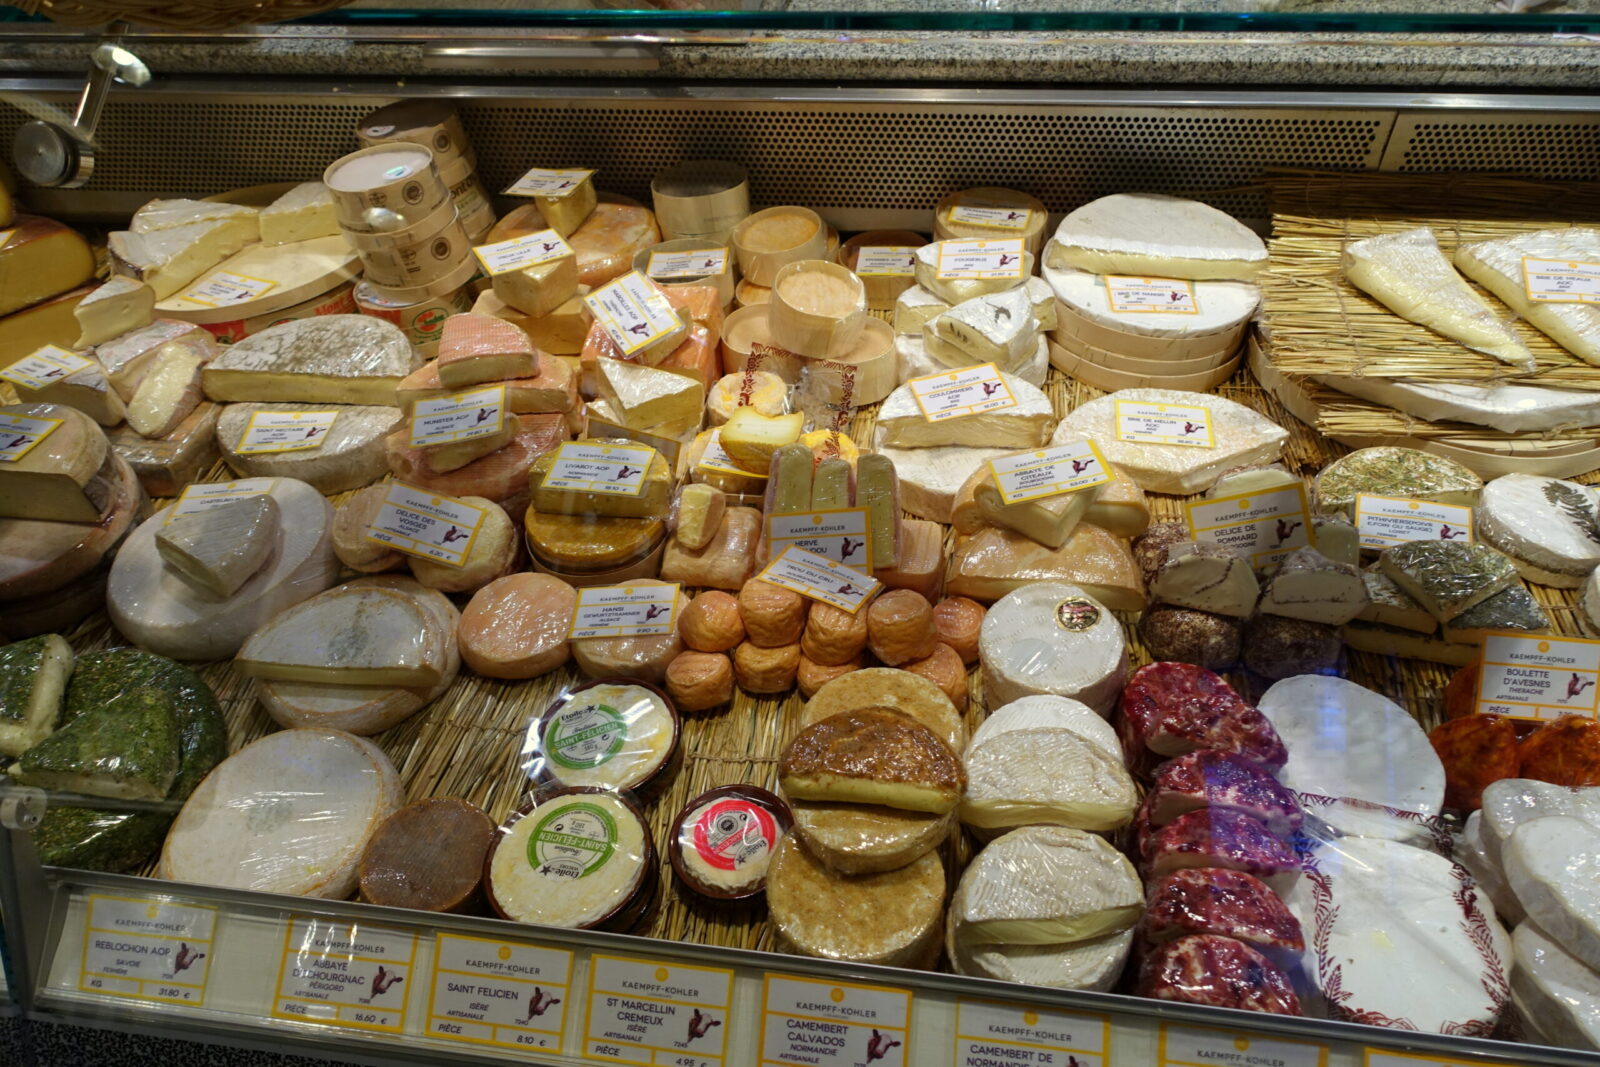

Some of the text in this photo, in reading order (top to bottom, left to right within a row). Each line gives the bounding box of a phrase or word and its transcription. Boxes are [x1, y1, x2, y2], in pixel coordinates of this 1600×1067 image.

[1014, 468, 1043, 477] ABBAYE
[1214, 526, 1242, 537] DELICE
[1509, 653, 1576, 664] KAEMPFF-KOHLER
[1506, 668, 1550, 678] BOULETTE
[1503, 677, 1551, 688] D'AVESNES
[554, 722, 618, 749] SAINT-FÉLICIEN
[539, 831, 608, 851] SAINT-FÉLICIEN
[96, 940, 171, 956] REBLOCHON AOP
[315, 940, 385, 954] KAMPFFKOHLER
[465, 959, 541, 975] KAEMPFF-KOHLER
[90, 979, 102, 987] KG
[293, 969, 365, 984] DCHOURGNAC
[159, 988, 180, 997] 31.80
[447, 982, 519, 1000] SAINT FELICIEN
[622, 980, 699, 997] KAEMPFF-KOHLER
[606, 997, 676, 1015] ST MARCELLIN
[796, 1001, 877, 1018] KAEMPFF-KOHLER
[355, 1013, 376, 1023] 16.60
[447, 1010, 484, 1020] ARTISANALE
[617, 1011, 664, 1026] CREMEUX
[786, 1018, 849, 1035] CAMEMBERT
[989, 1025, 1072, 1042] KAEMPFF-KOHLER
[516, 1035, 534, 1045] 8.10
[603, 1031, 643, 1042] ARTISANALE
[788, 1031, 846, 1047] CALVADOS
[790, 1044, 838, 1056] NORMANDIE
[970, 1044, 1053, 1063] CAMEMBERT DE
[676, 1057, 695, 1066] 4.95
[779, 1053, 820, 1064] ARTISANALE
